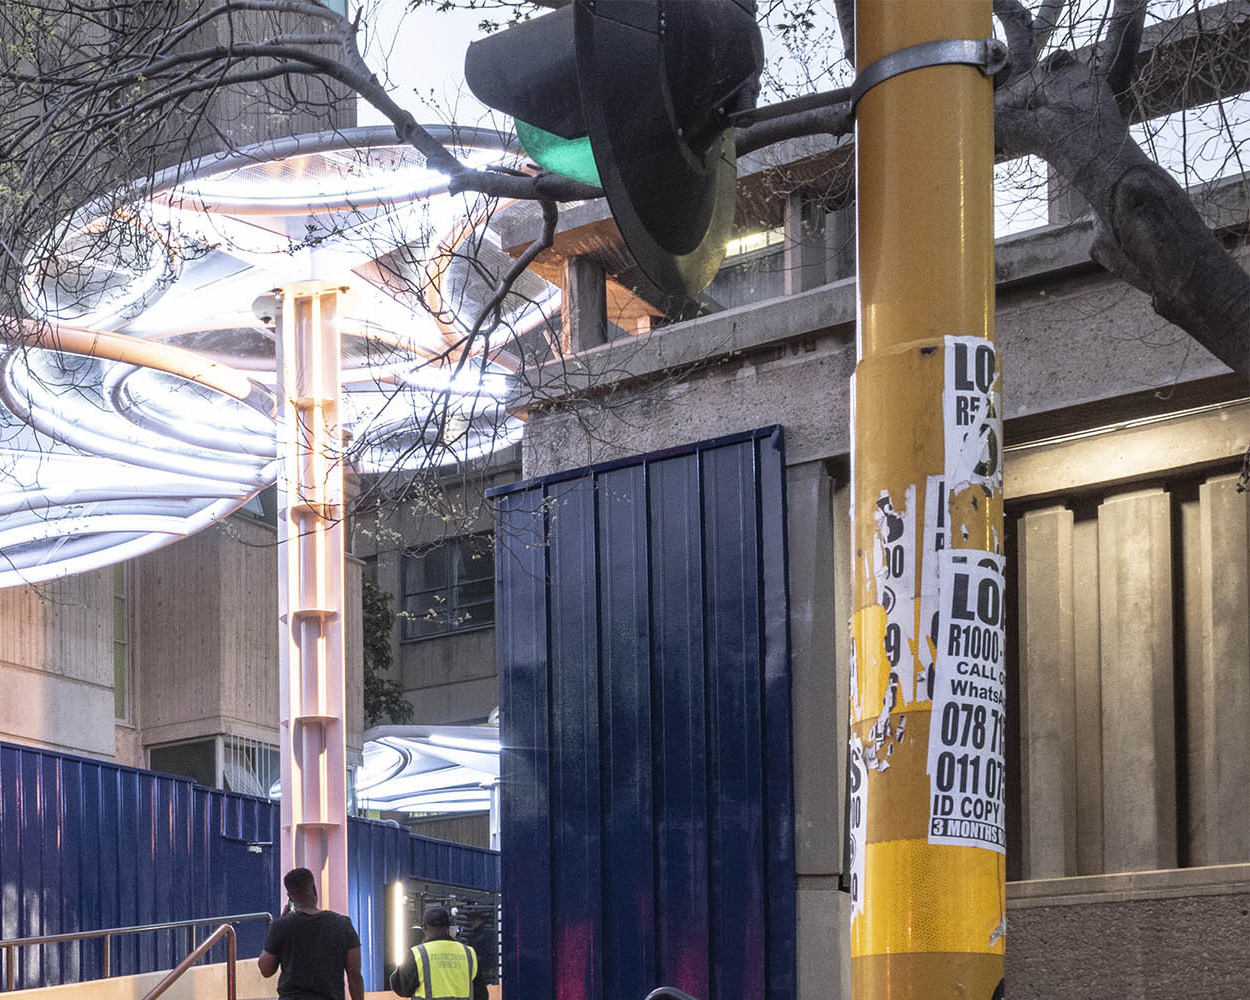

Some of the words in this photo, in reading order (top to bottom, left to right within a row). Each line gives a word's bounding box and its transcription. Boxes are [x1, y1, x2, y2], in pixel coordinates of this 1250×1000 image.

[956, 661, 997, 681] CALL
[941, 701, 987, 750] 078
[936, 751, 981, 795] 011
[933, 794, 954, 816] ID
[960, 796, 1000, 824] COPY
[933, 819, 944, 836] 3
[947, 819, 998, 844] MONTHS
